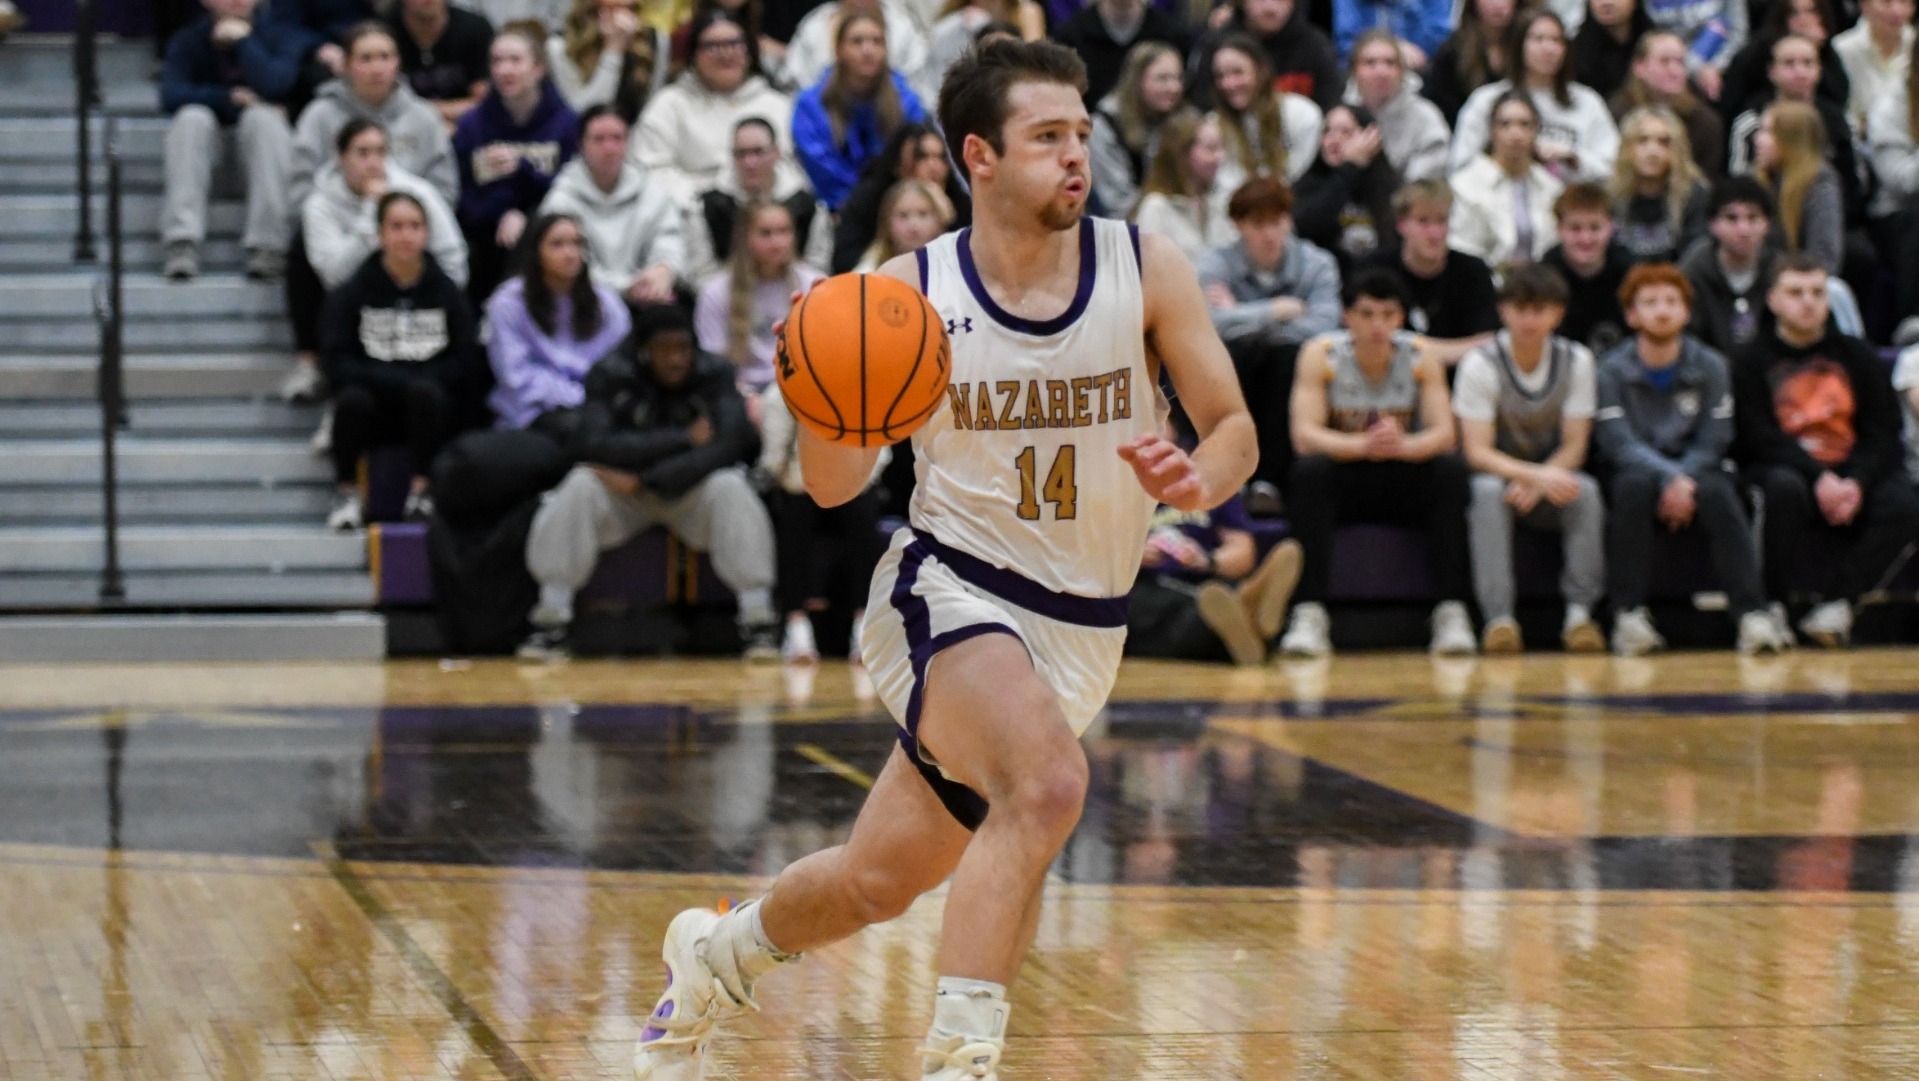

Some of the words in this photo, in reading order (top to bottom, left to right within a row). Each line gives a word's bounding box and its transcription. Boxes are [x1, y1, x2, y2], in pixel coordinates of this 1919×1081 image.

[777, 331, 796, 381] ON
[948, 367, 1131, 431] NAZARETH
[1015, 444, 1077, 520] 14
